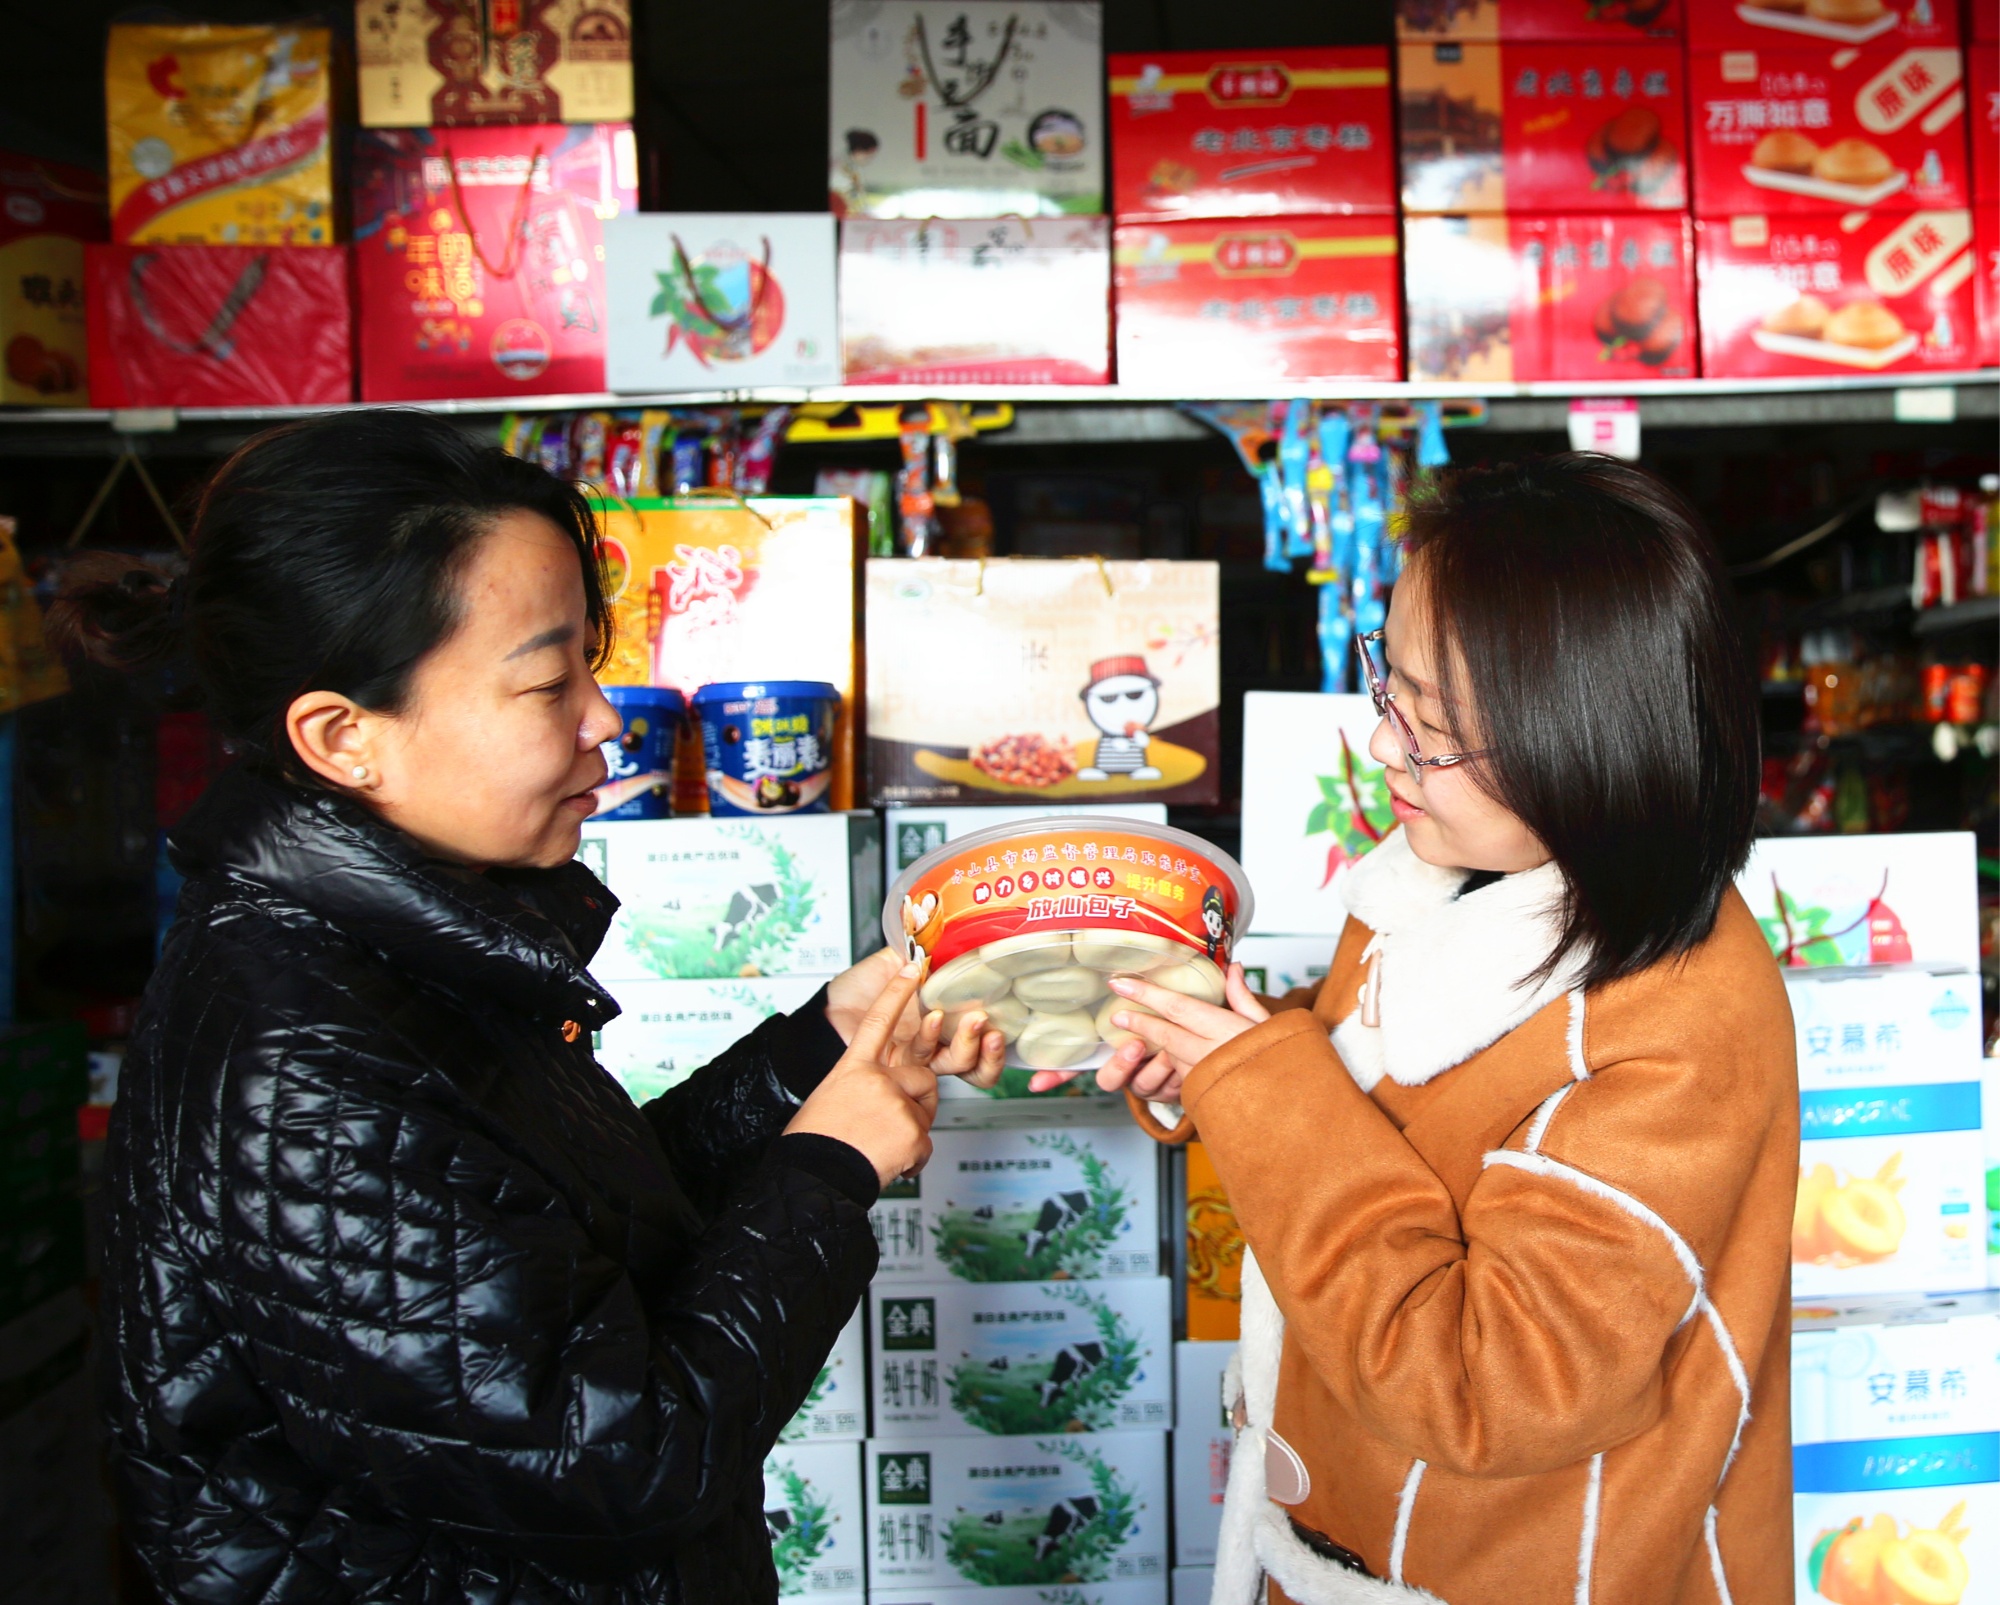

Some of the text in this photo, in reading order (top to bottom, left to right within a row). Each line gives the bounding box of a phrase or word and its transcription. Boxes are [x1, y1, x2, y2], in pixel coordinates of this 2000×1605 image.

[1873, 60, 1938, 123] 原味
[1882, 222, 1946, 283] 原味
[742, 734, 828, 781] 麦丽素
[974, 867, 1113, 902] 助力乡村振兴
[1125, 872, 1185, 902] 提升服务
[1026, 895, 1138, 922] 放心包子
[1806, 1022, 1902, 1058] 安慕希
[886, 1303, 931, 1338] 金典
[883, 1359, 938, 1409] 纯牛奶
[1867, 1368, 1968, 1406] 安慕希
[880, 1457, 927, 1492] 金典
[878, 1513, 934, 1561] 纯牛奶
